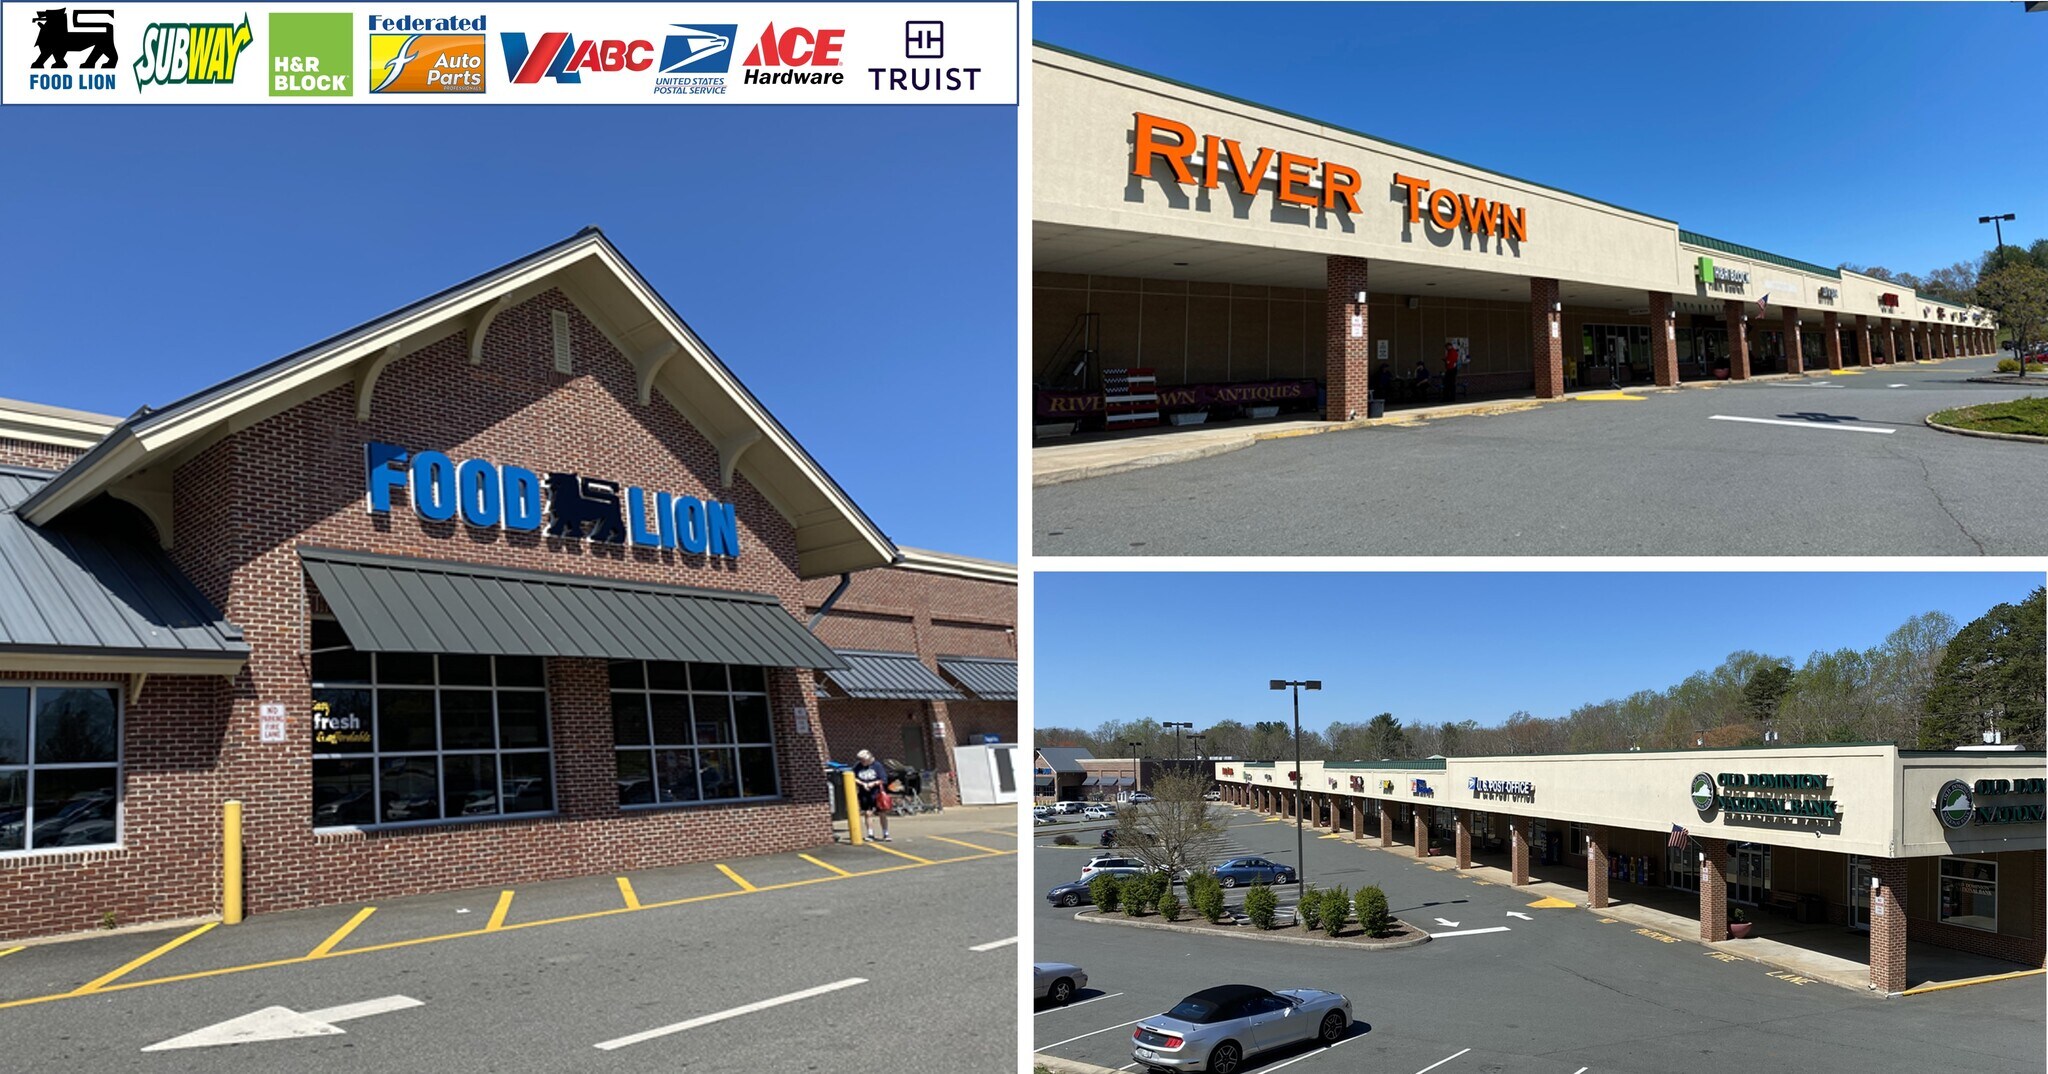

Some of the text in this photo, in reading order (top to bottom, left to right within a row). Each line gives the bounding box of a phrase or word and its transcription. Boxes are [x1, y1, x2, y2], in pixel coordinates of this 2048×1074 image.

[1132, 111, 1528, 242] RIVER TOWN
[1048, 394, 1117, 412] RIVE
[1213, 384, 1302, 401] ANTIQUES
[364, 442, 740, 559] FOOD LION
[313, 712, 361, 730] fresh
[1489, 780, 1505, 793] POST
[1505, 781, 1531, 794] OFFICE
[1717, 773, 1829, 790] OLD DOMINION
[1974, 779, 2011, 796] OLD
[1716, 796, 1838, 818] NATIONAL BANK
[1765, 970, 1819, 986] LANE
